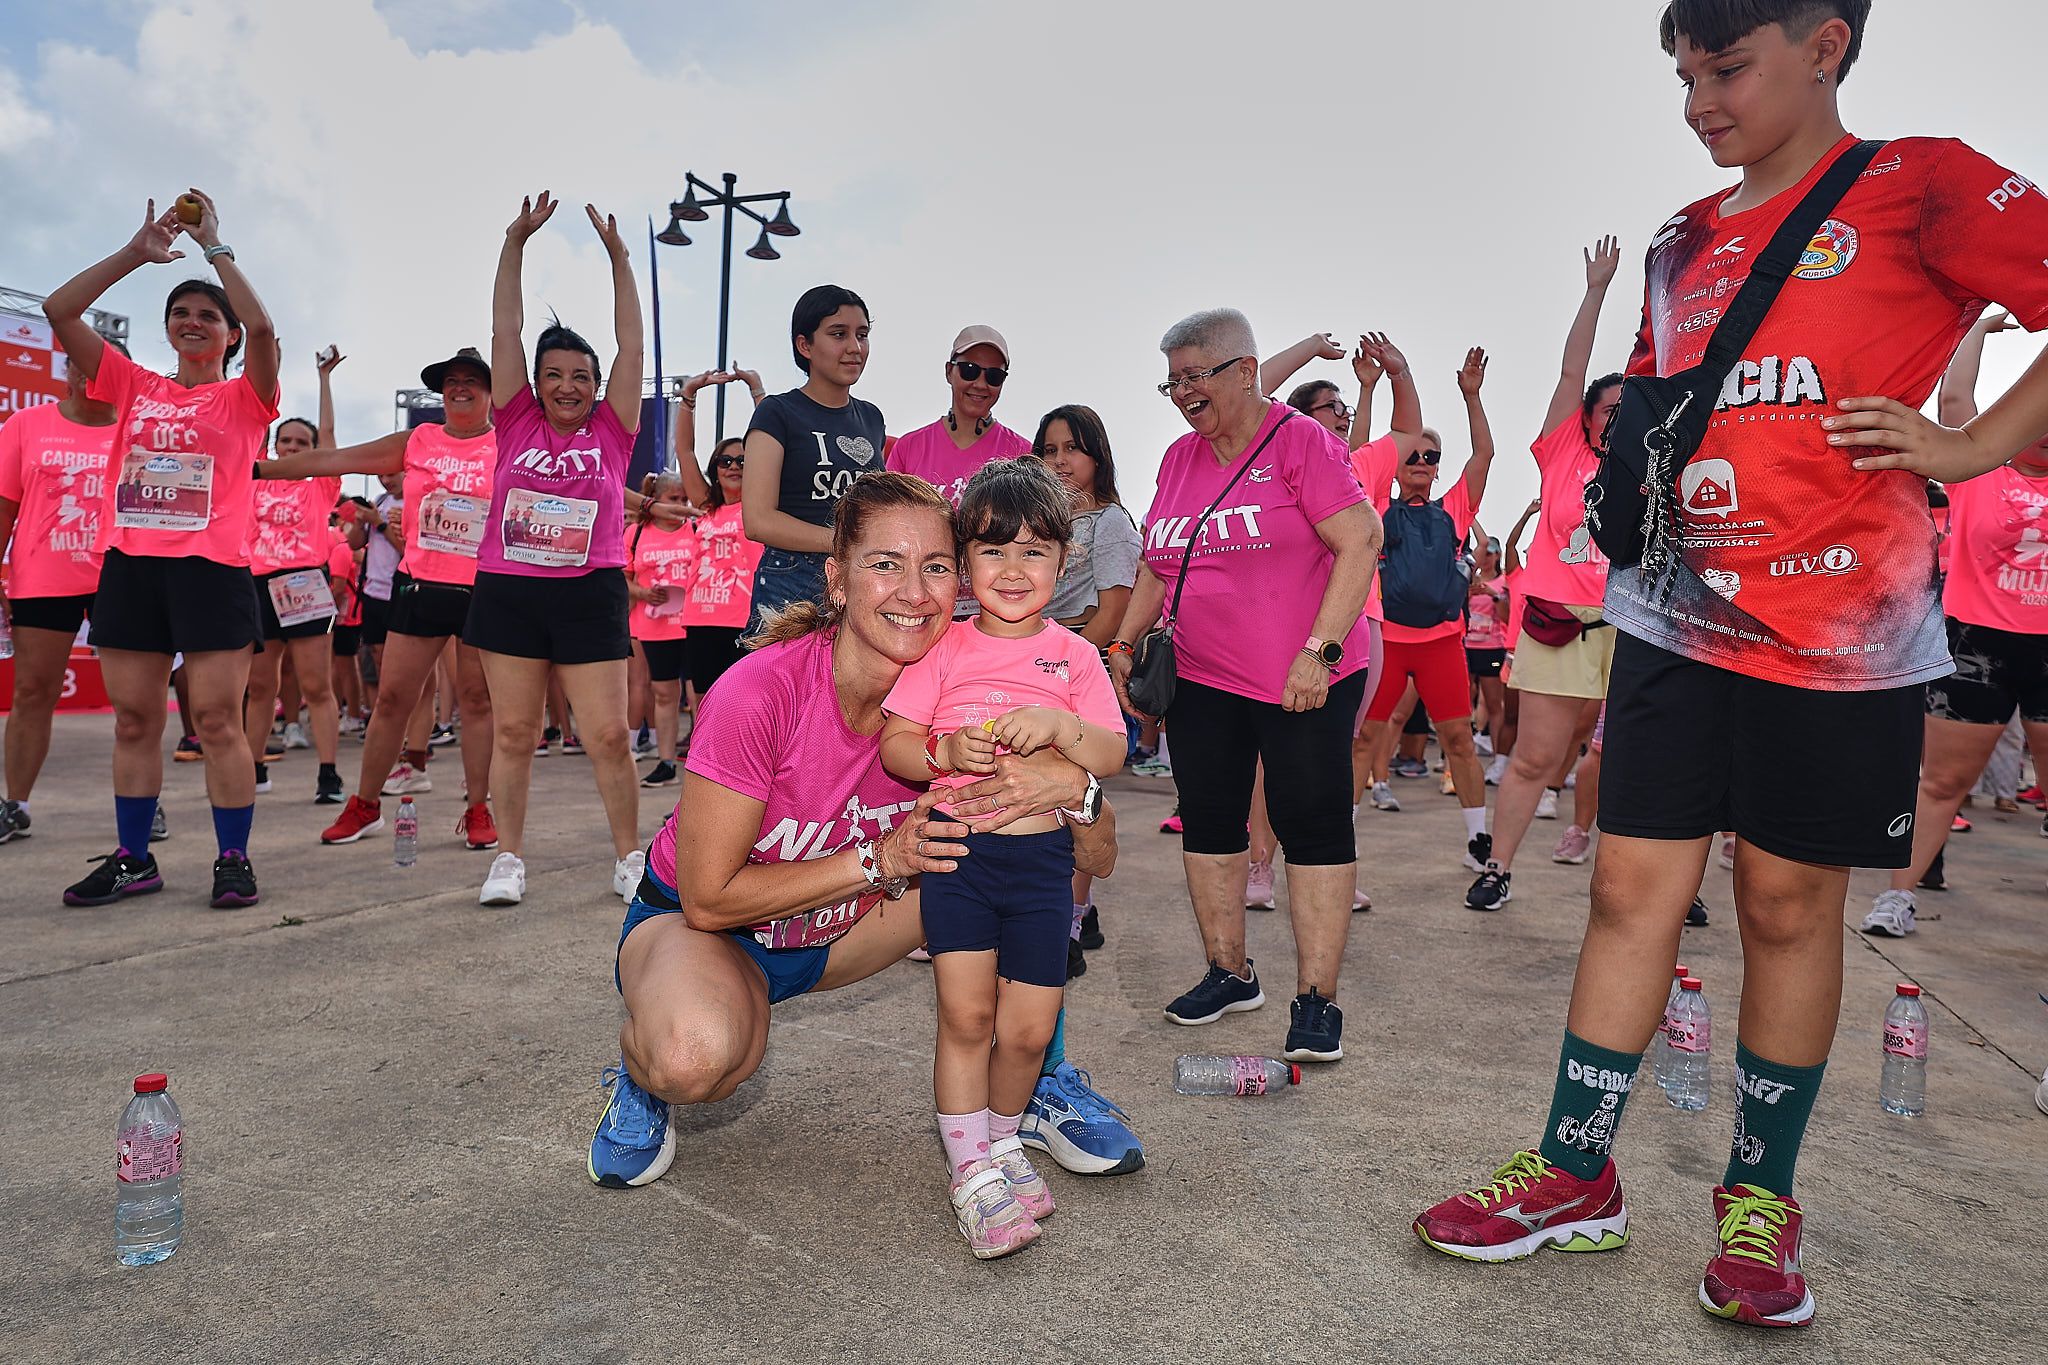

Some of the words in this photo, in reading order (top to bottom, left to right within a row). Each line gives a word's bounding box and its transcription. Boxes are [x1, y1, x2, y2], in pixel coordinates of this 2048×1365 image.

[1801, 269, 1834, 278] MURCIA
[1738, 412, 1825, 423] Sardinera
[811, 431, 834, 467] I
[453, 472, 473, 493] DE
[811, 469, 866, 501] SO
[141, 486, 178, 501] 016
[442, 519, 469, 533] 016
[529, 523, 563, 538] 016
[715, 538, 731, 559] DE
[1247, 542, 1271, 550] TEAM
[642, 549, 692, 562] CARRERA
[1779, 551, 1810, 561] GRUPO
[671, 563, 687, 580] DE
[691, 586, 731, 604] MUJER
[2019, 593, 2048, 606] 2026
[1864, 642, 1885, 653] Marte
